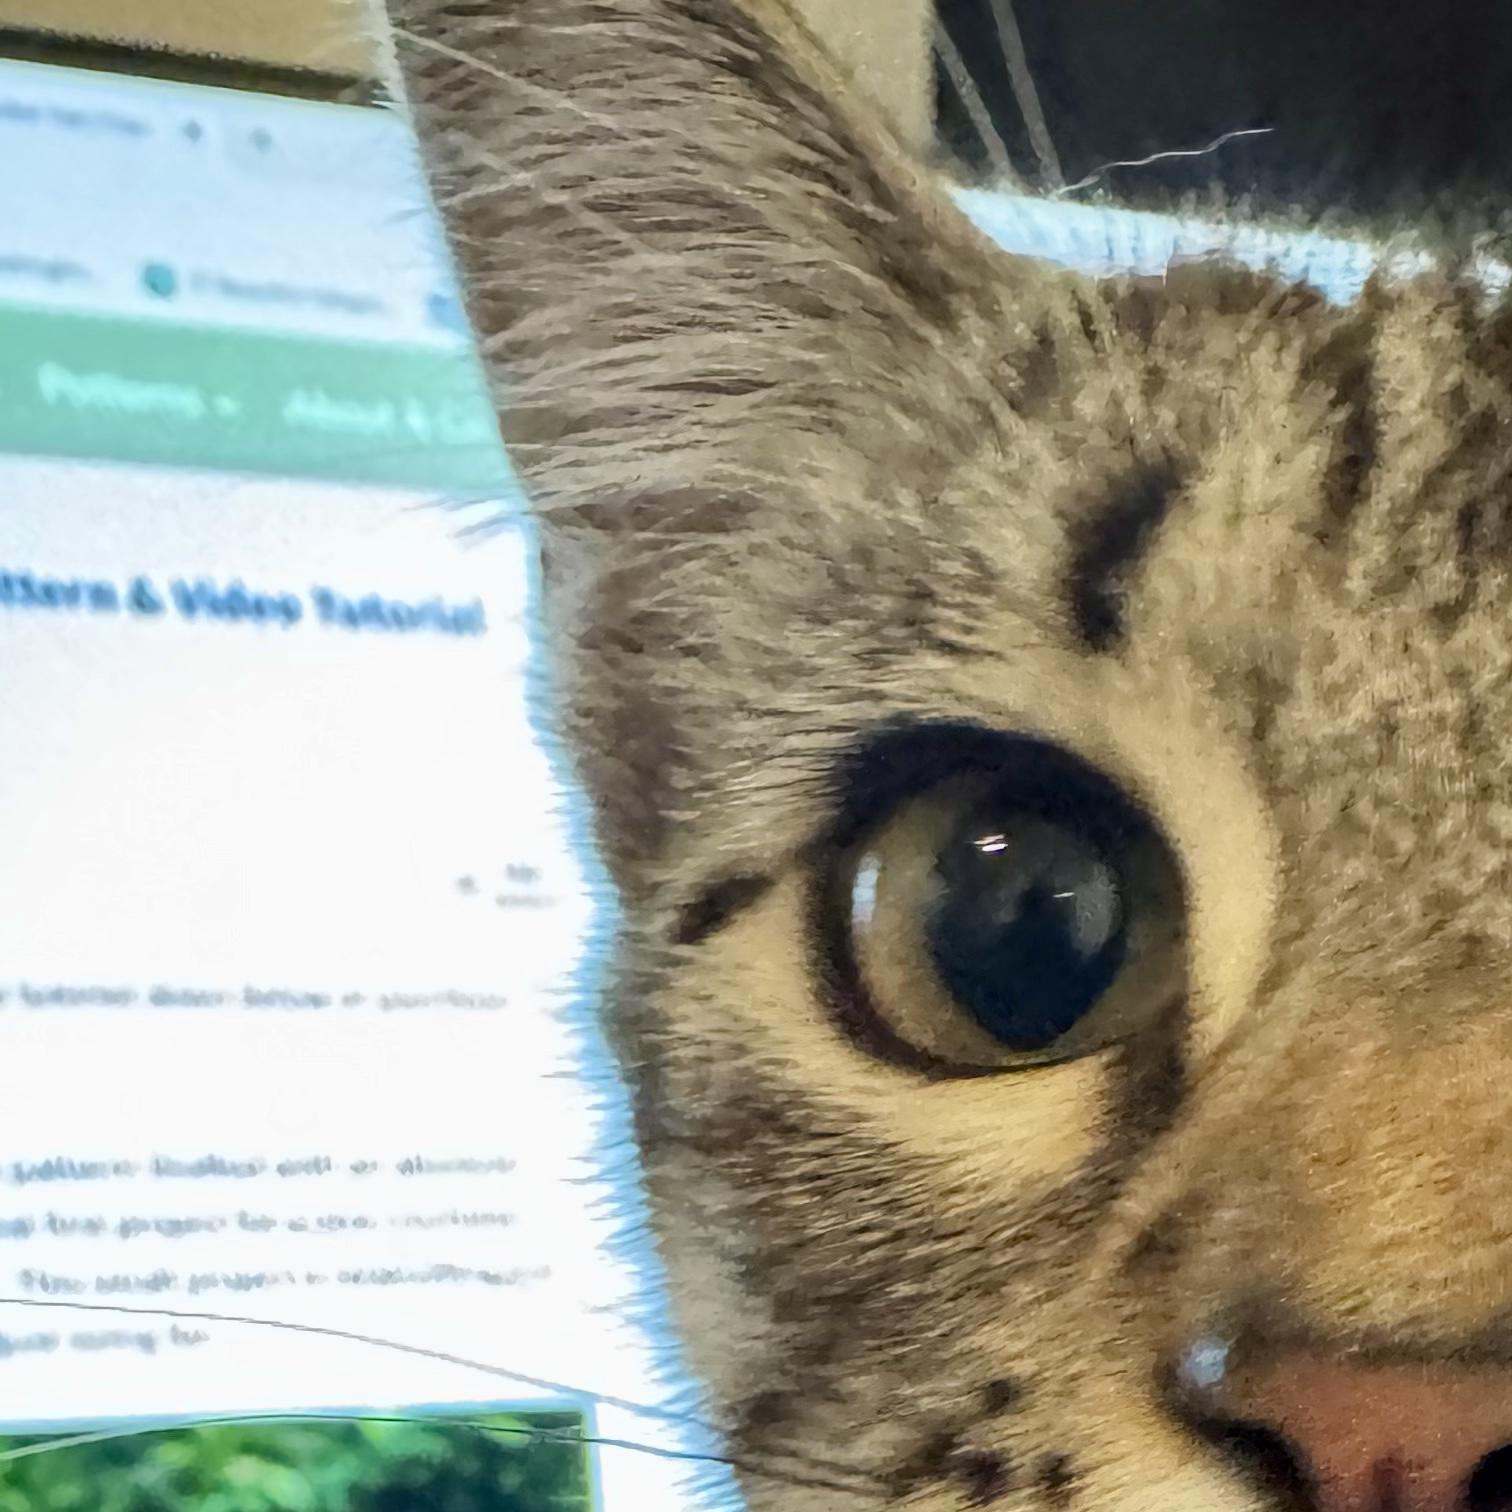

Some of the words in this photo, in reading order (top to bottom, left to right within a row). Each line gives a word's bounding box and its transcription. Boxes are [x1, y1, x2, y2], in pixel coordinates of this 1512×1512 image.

[127, 573, 166, 615] &
[170, 574, 303, 627] Video
[309, 584, 487, 636] Tutorial
